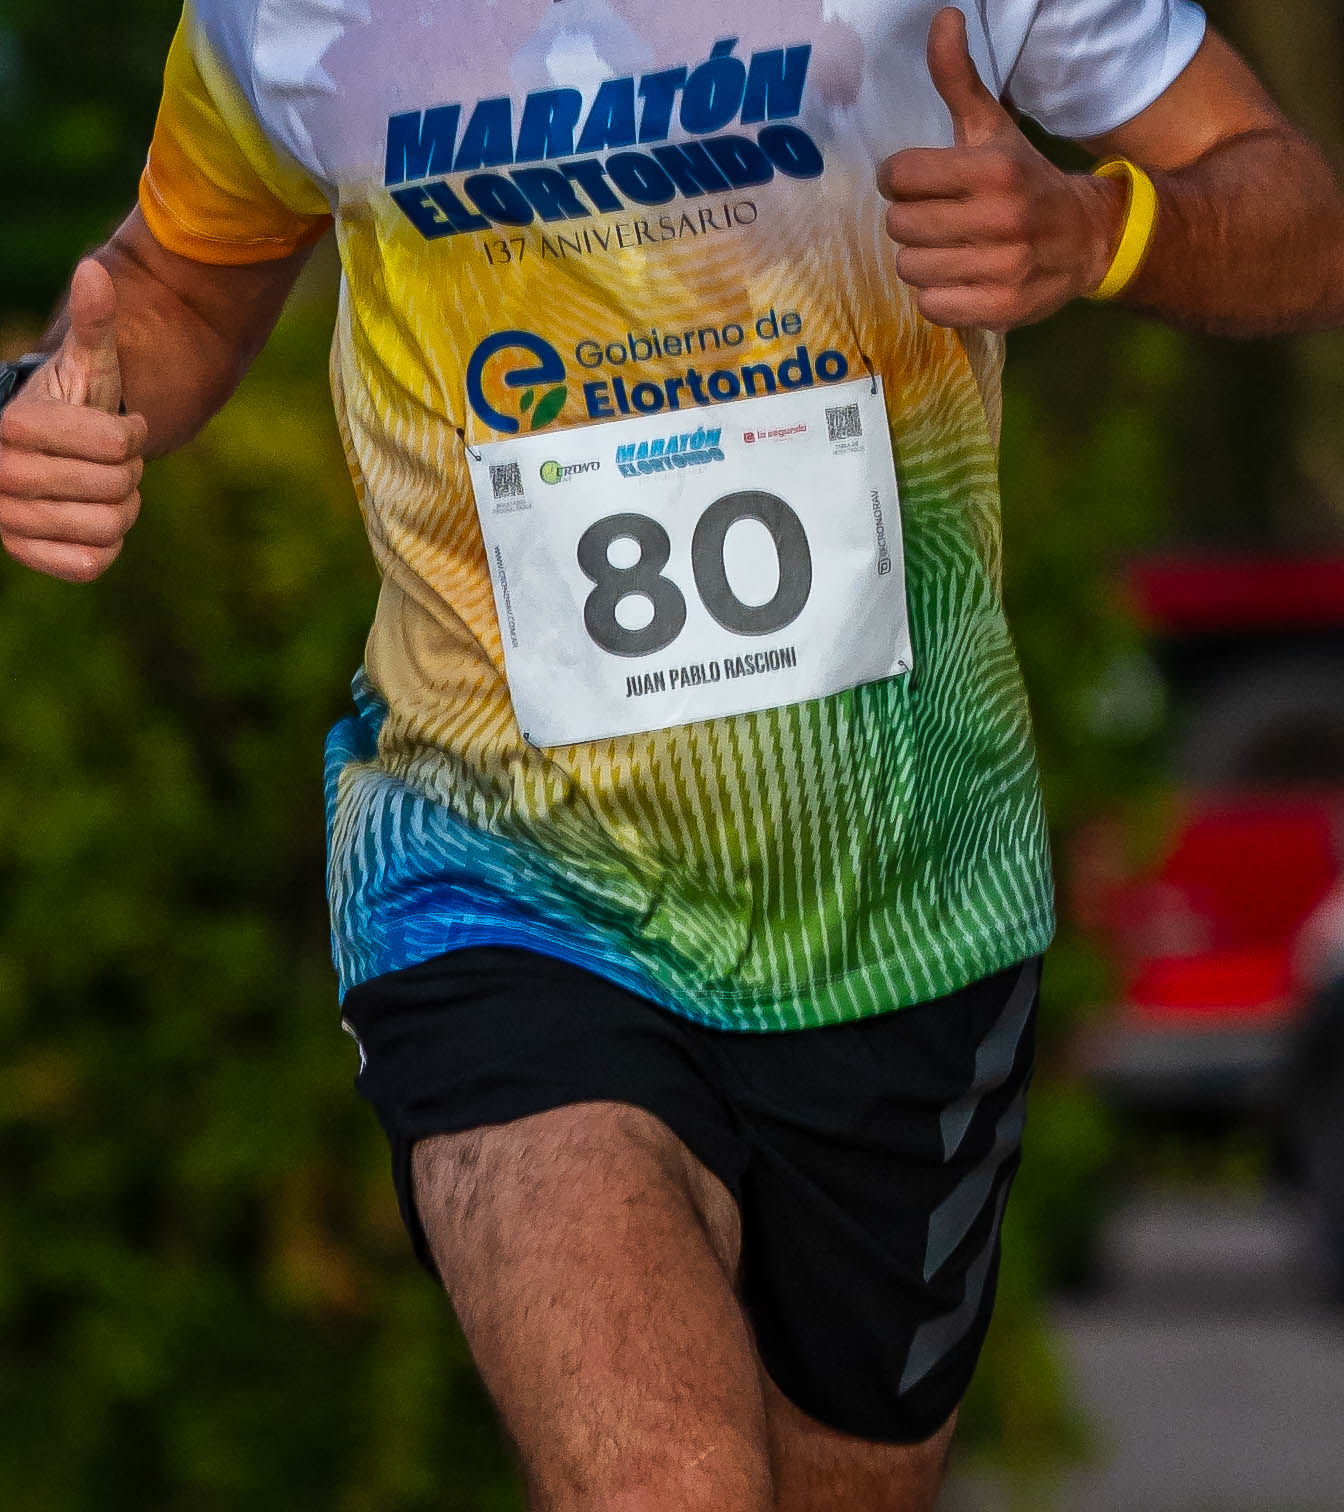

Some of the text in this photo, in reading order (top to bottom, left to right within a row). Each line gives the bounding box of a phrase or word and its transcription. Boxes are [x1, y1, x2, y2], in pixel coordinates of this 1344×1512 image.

[385, 36, 812, 187] MARATÓN
[389, 124, 825, 241] ELORTONDO
[483, 201, 758, 266] 137 ANIVERSARIO
[574, 307, 803, 369] Gobierno de
[582, 345, 849, 419] Elortondo
[576, 489, 813, 659] 80
[625, 645, 797, 698] JUAN PABLO RASCIONI
